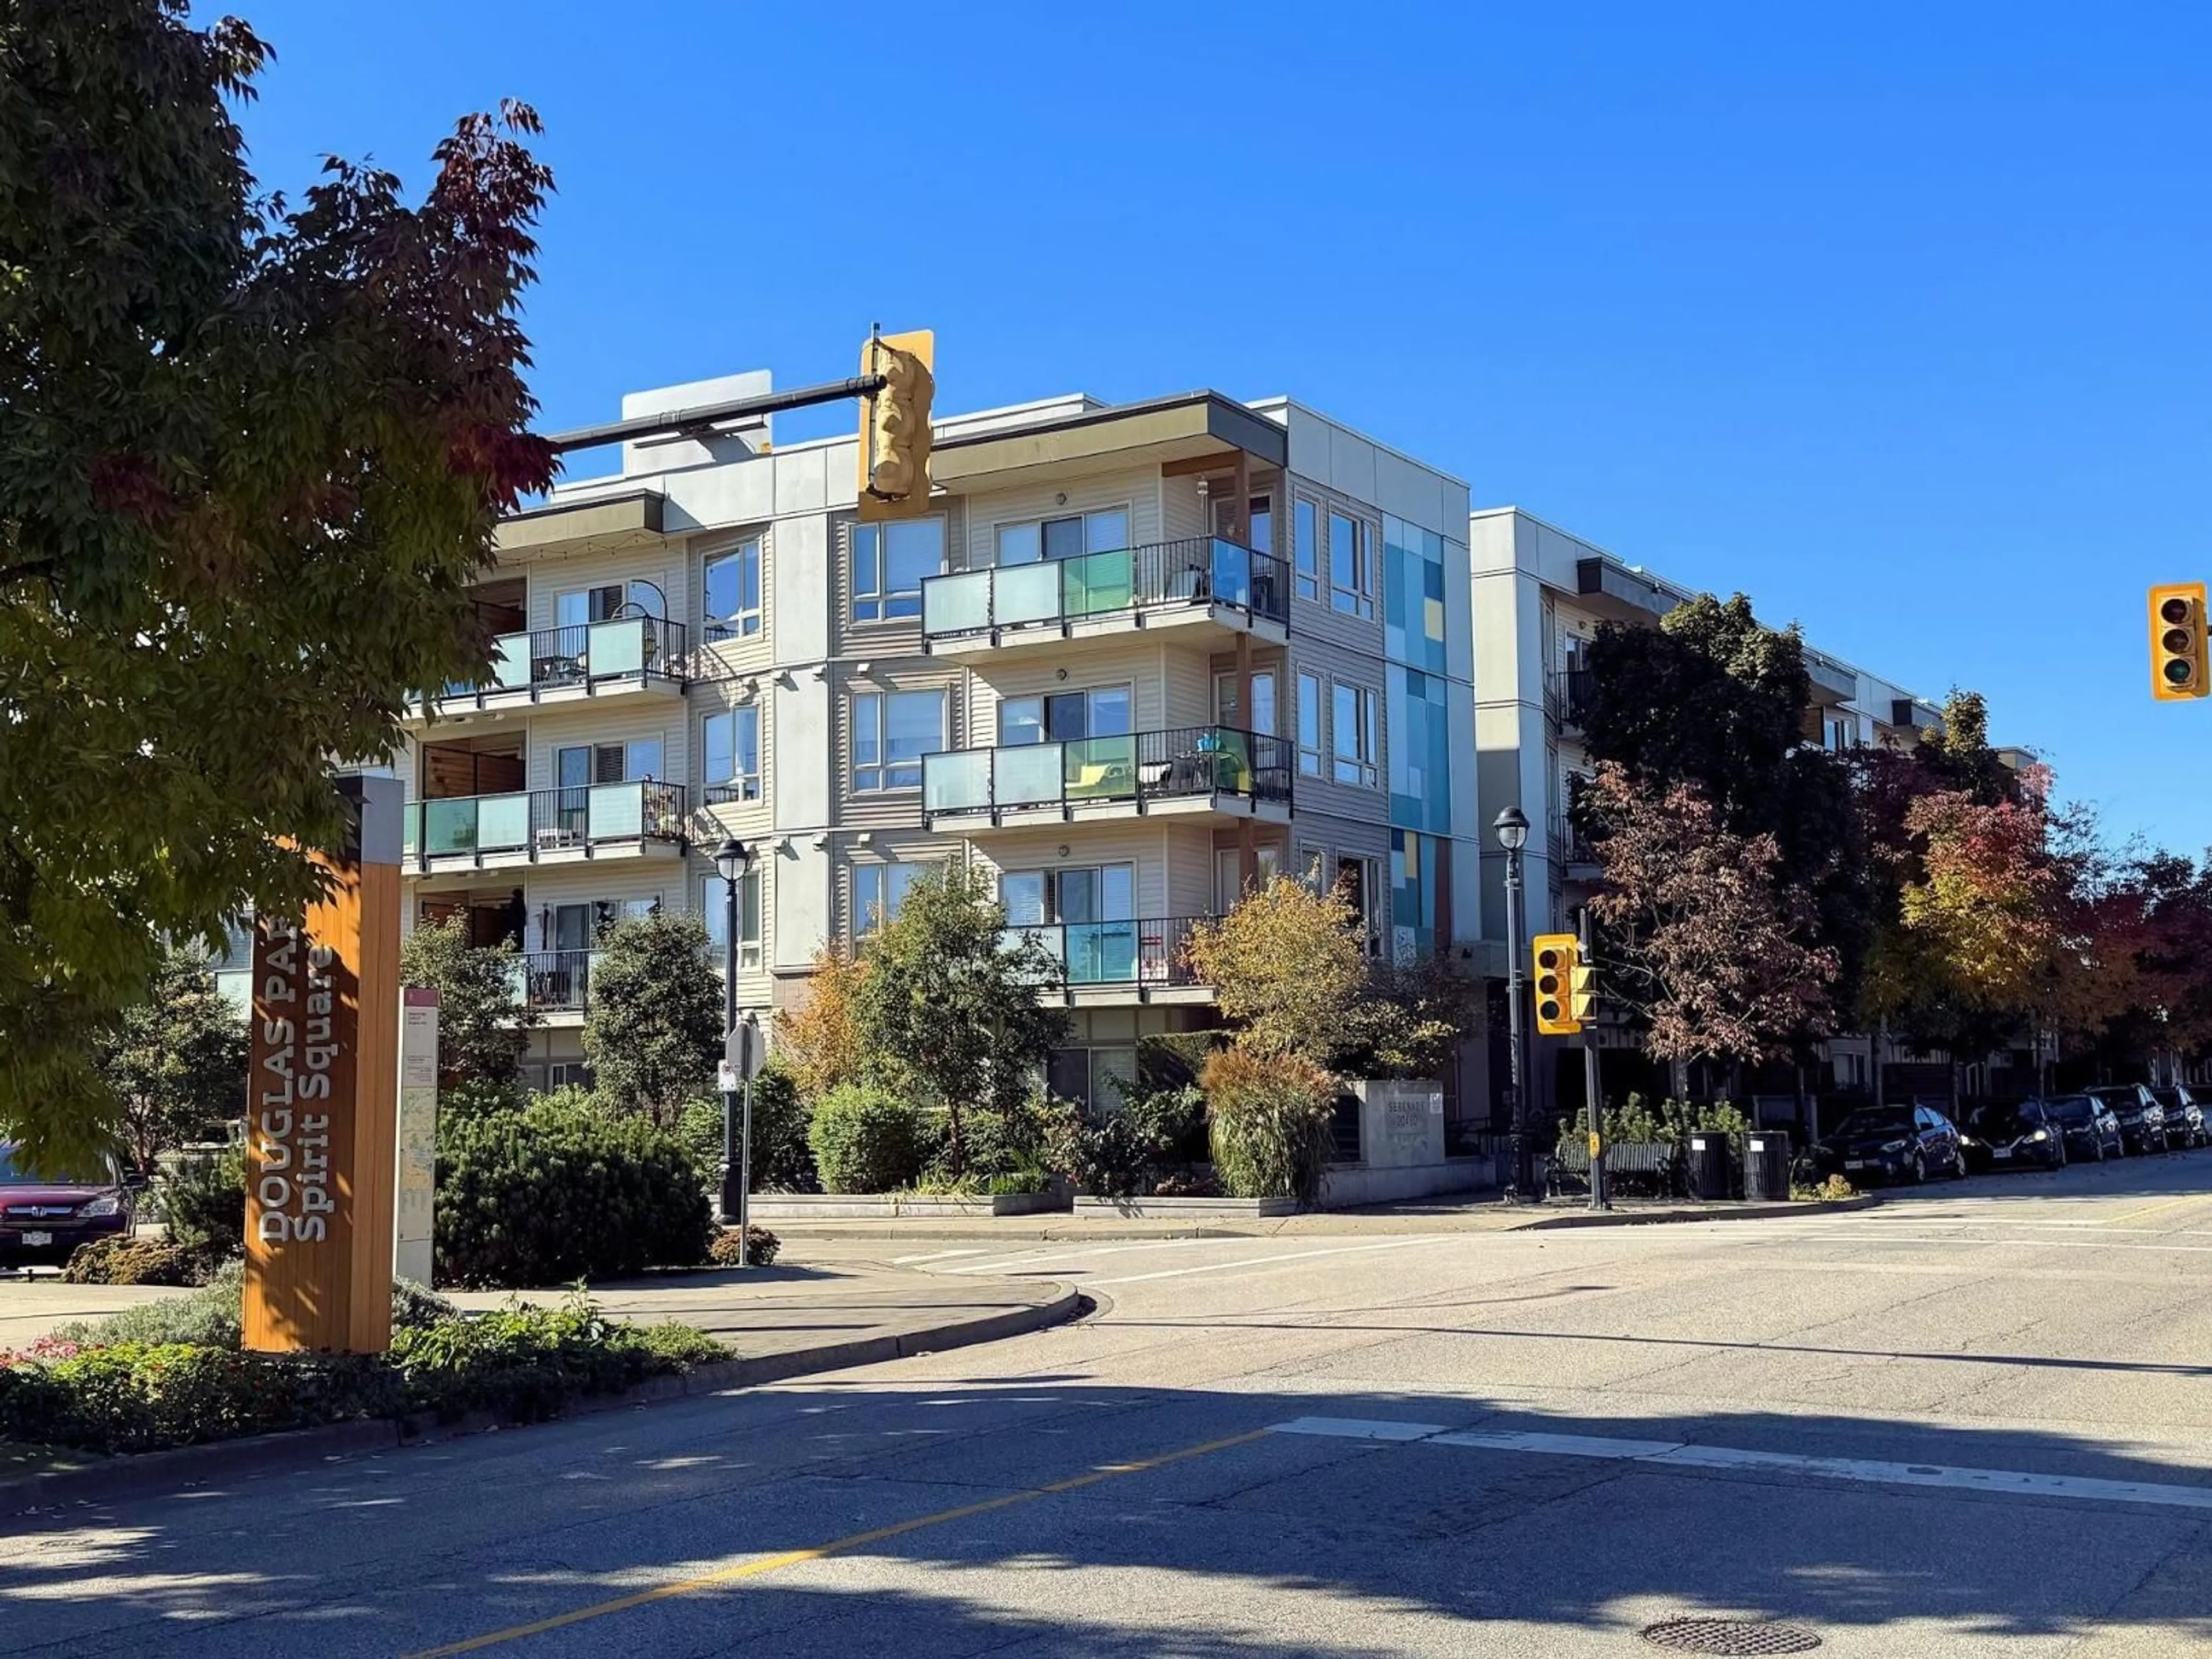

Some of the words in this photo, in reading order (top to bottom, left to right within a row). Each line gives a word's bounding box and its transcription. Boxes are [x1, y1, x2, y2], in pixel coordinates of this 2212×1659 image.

[265, 914, 298, 1002] PAR
[298, 945, 339, 1099] Square
[258, 1018, 295, 1242] DOUGLAS
[294, 1114, 335, 1242] Spirit
